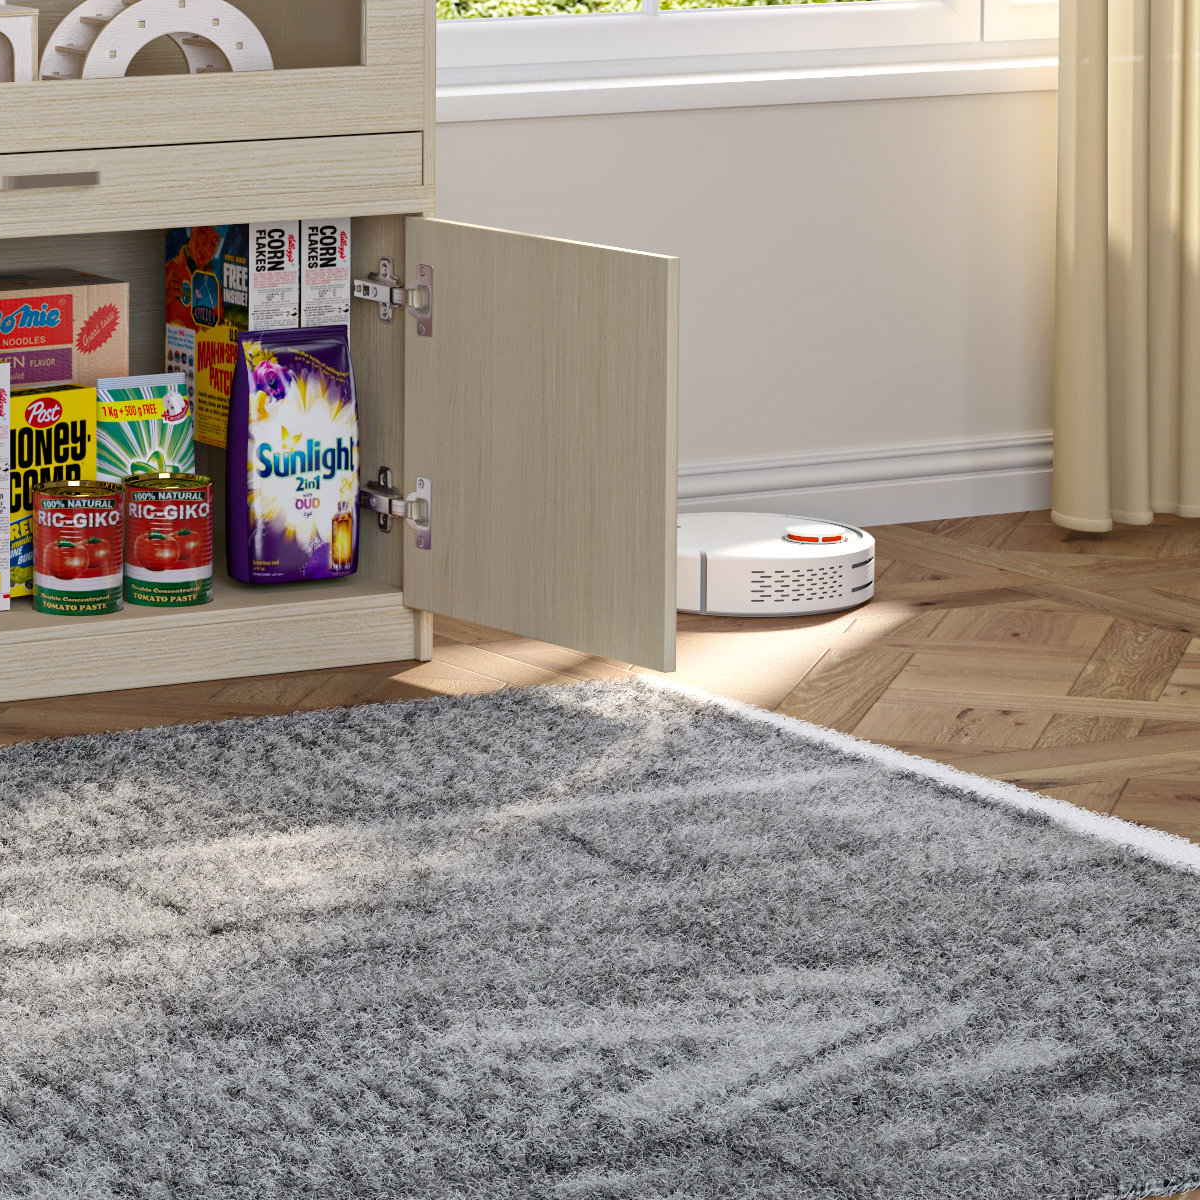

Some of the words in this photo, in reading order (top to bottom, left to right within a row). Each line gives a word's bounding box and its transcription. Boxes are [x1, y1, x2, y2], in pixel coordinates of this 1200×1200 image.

[255, 230, 267, 272] FLAKES
[267, 228, 285, 272] CORN
[307, 226, 319, 269] FLAKES
[319, 225, 337, 268] CORN
[223, 262, 248, 292] FREE
[2, 336, 46, 347] NOODLES
[30, 358, 56, 368] FLAVOR
[197, 341, 239, 372] MAN-IN-SPA
[27, 401, 61, 424] Post
[108, 406, 119, 419] Kg
[124, 405, 136, 417] 500
[138, 407, 143, 418] g
[142, 403, 158, 415] FREE
[256, 436, 355, 480] Sunlight
[295, 475, 320, 492] 2in1
[42, 500, 65, 508] 100%
[67, 499, 113, 508] NATURAL
[133, 492, 155, 501] 100%
[157, 492, 203, 500] NATURAL
[295, 497, 321, 510] OUD
[38, 510, 120, 528] RIC-GIKO
[128, 502, 210, 521] RIC-GIKO
[40, 592, 62, 601] Double
[62, 594, 110, 603] Concentrated
[131, 583, 153, 593] Double
[153, 585, 200, 595] Concentrated
[133, 593, 168, 603] TOMATO
[169, 594, 198, 603] PASTE
[42, 602, 78, 612] TOMATO
[79, 602, 108, 611] PASTE
